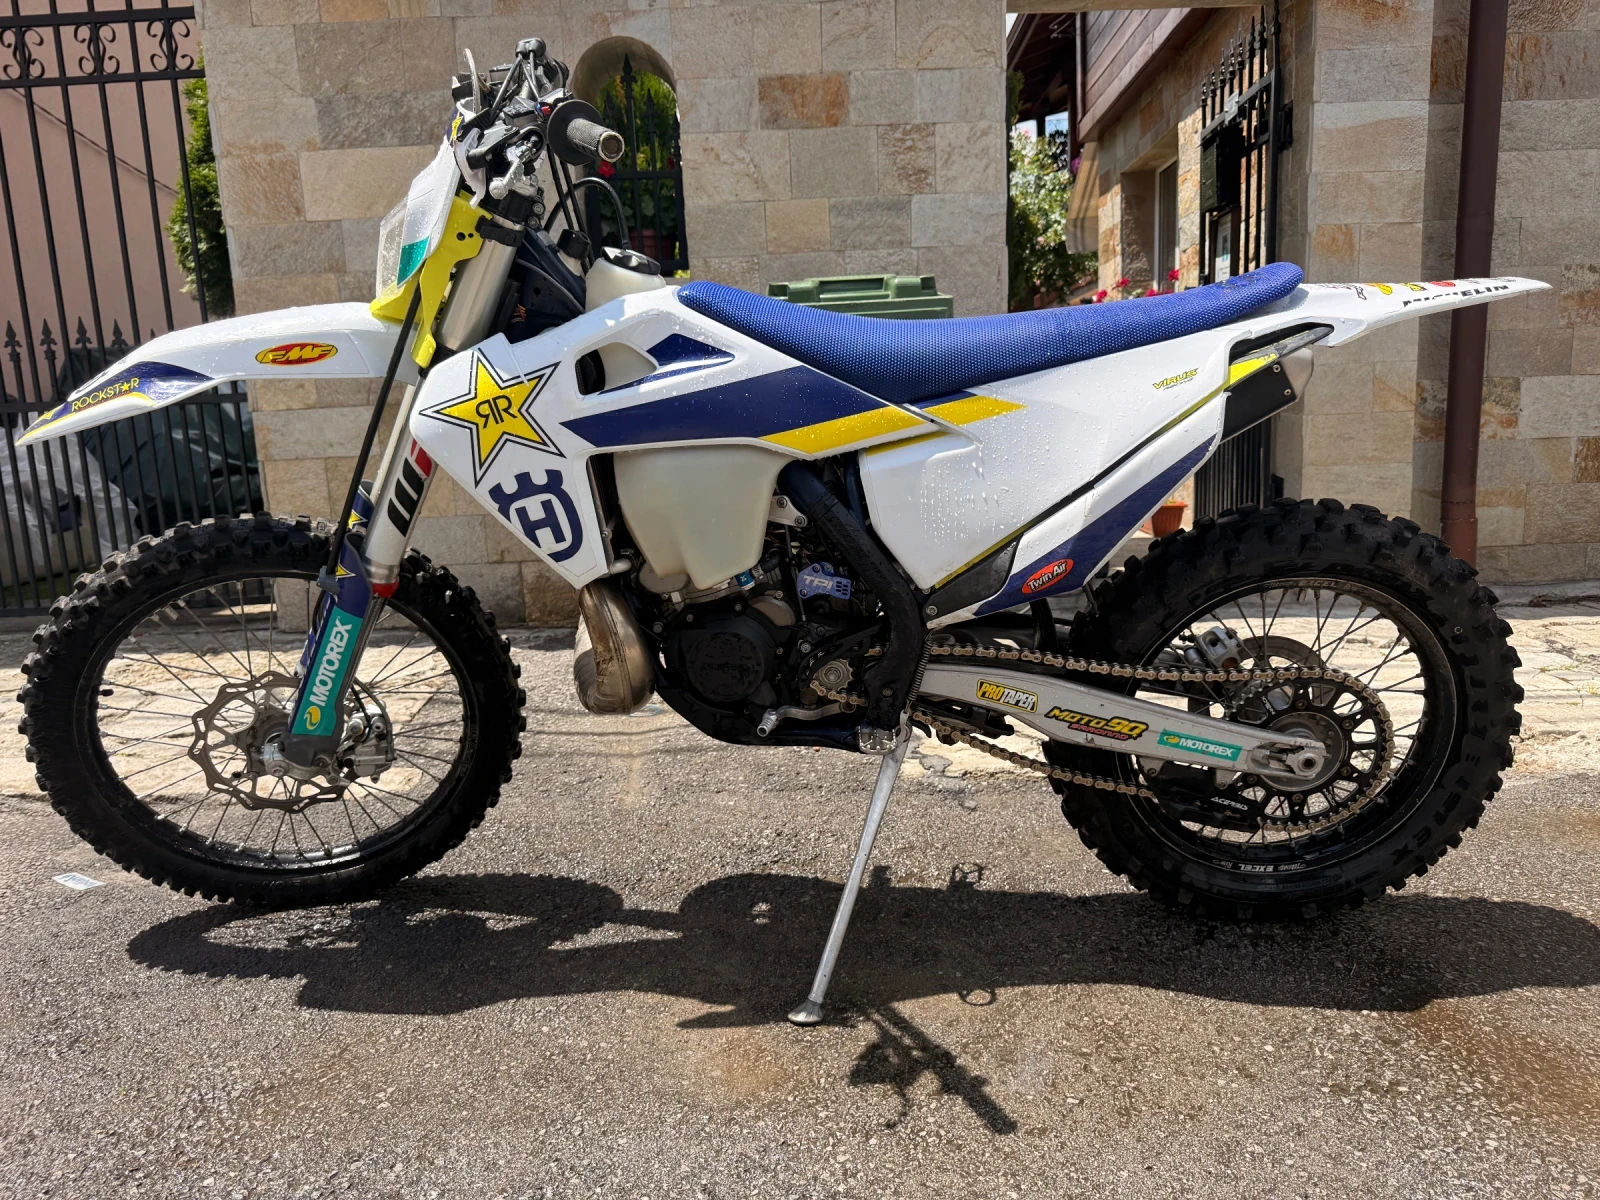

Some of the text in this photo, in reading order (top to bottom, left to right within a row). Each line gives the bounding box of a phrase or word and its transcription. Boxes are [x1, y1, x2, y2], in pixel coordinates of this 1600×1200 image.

[260, 344, 338, 364] FMF
[1152, 368, 1199, 389] VIRUS
[803, 574, 833, 590] TPI
[1028, 561, 1068, 591] Twin Air
[309, 619, 352, 707] MOTOREX
[1179, 737, 1236, 758] MOTOREX
[1238, 863, 1274, 873] EXCEL
